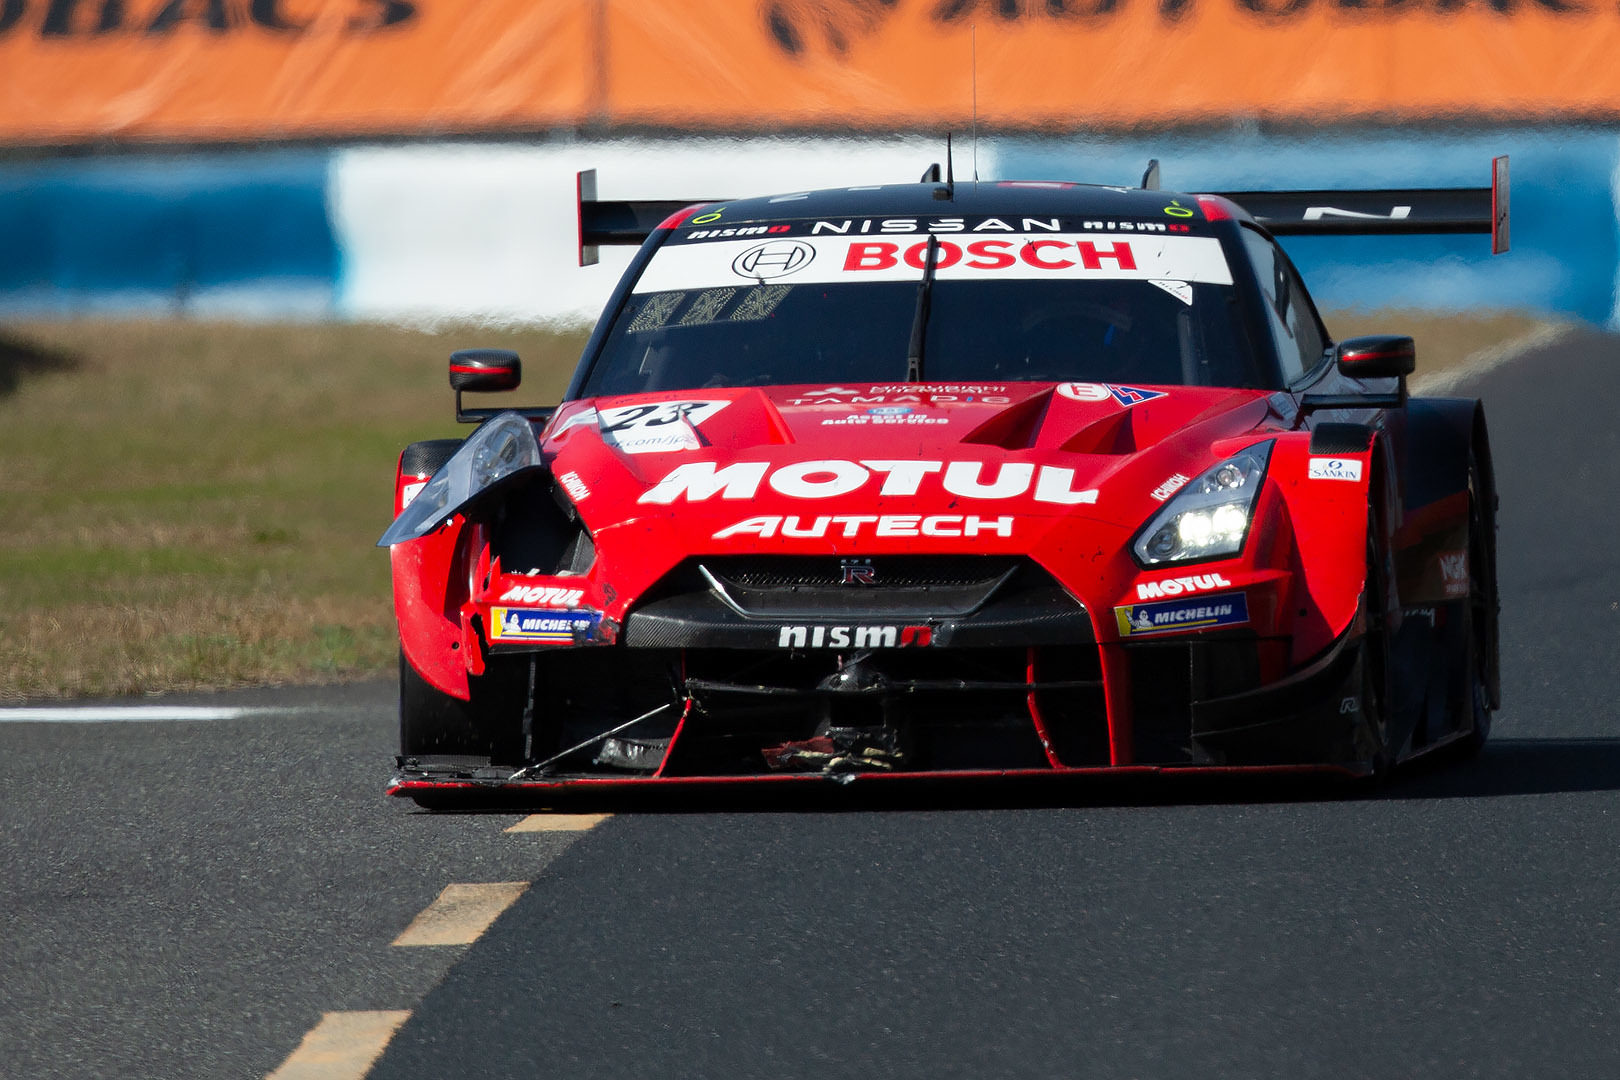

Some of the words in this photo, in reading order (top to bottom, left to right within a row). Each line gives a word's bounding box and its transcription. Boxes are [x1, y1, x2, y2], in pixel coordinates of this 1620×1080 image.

[811, 218, 1061, 235] NISSAN
[843, 239, 1137, 272] BOSCH
[637, 460, 1100, 505] MOTUL
[712, 515, 1014, 539] AUTECH
[499, 586, 584, 606] MOTUL
[1136, 573, 1231, 600] MOTUL
[1154, 604, 1232, 624] MICHELIN
